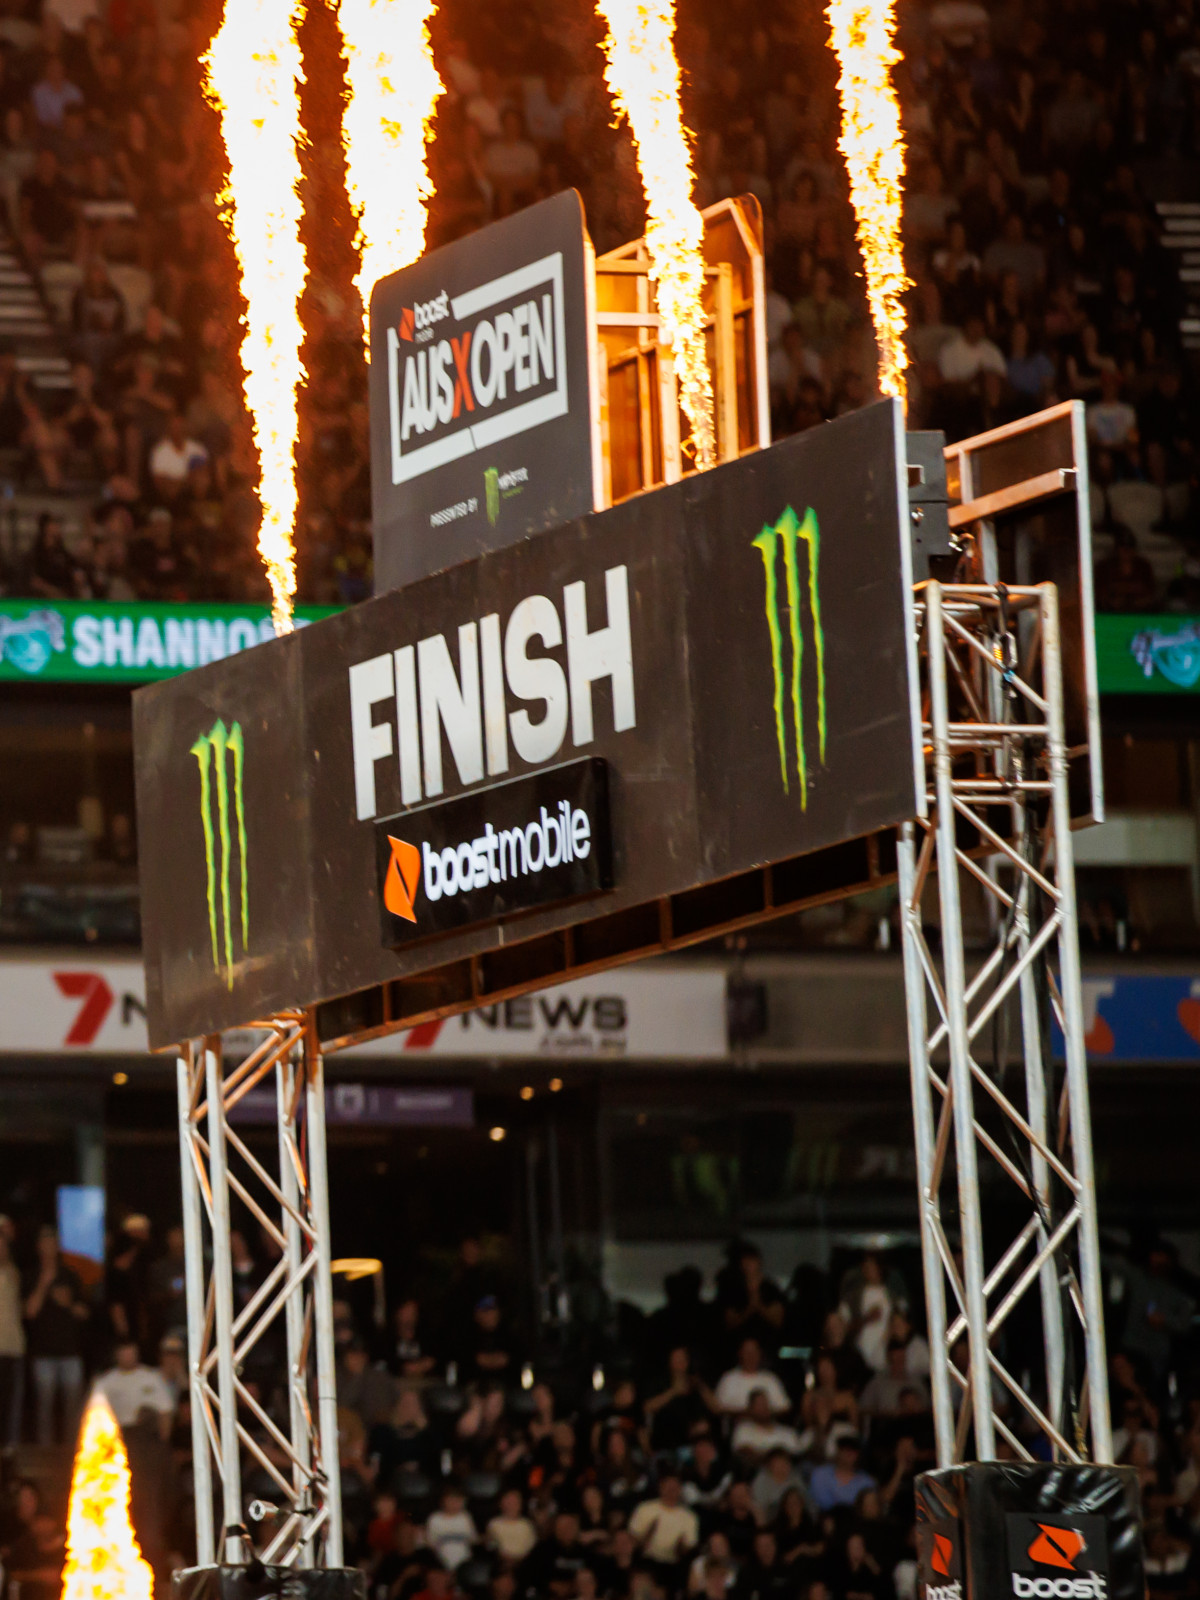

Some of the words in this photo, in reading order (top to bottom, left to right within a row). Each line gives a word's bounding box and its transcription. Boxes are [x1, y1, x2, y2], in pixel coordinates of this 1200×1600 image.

[414, 289, 450, 330] boost
[348, 564, 636, 821] FINISH
[1012, 1570, 1108, 1600] boost
